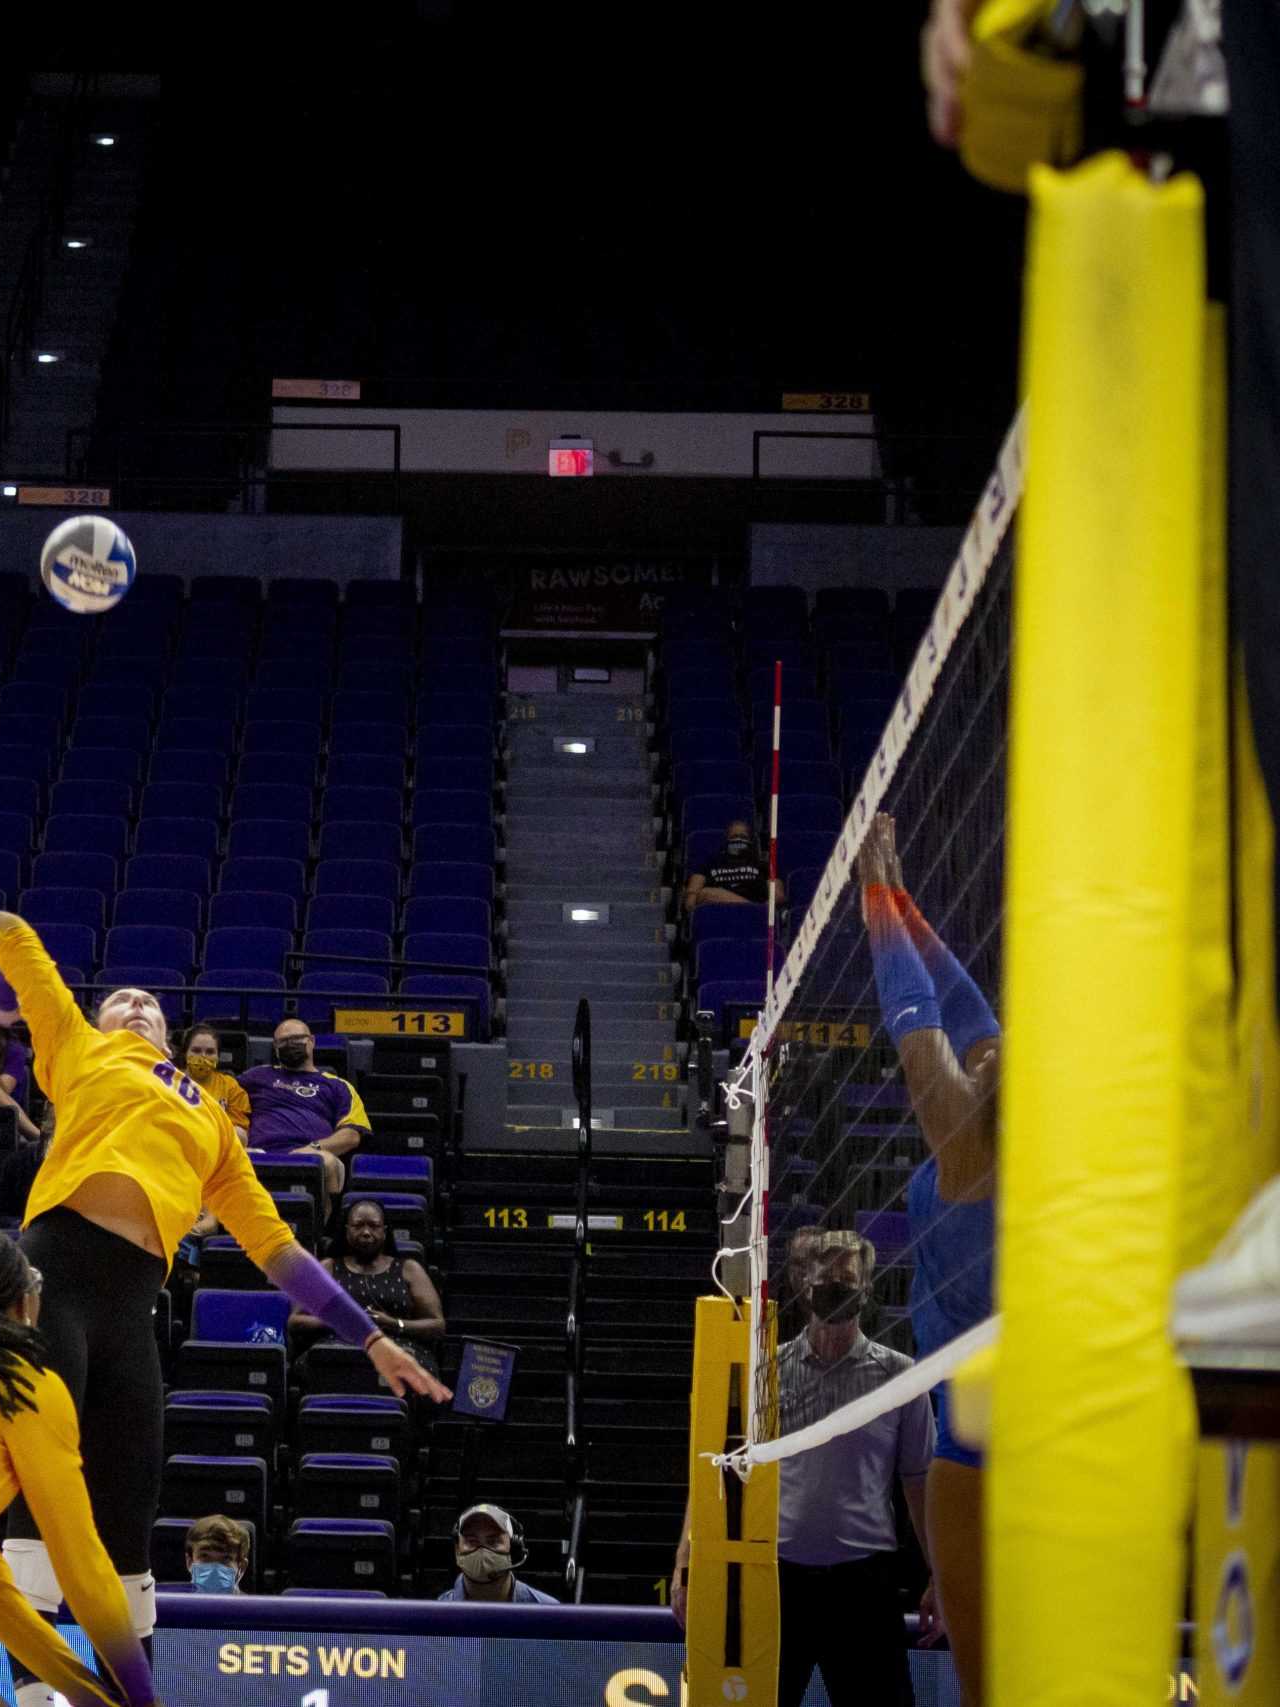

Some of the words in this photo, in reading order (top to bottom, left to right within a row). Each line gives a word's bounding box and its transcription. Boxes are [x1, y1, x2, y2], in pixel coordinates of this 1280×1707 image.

[820, 395, 863, 410] 328
[63, 489, 105, 505] 328
[391, 1013, 452, 1033] 113
[794, 1023, 857, 1045] 114
[509, 1062, 554, 1079] 218
[632, 1062, 680, 1081] 219
[483, 1207, 529, 1230] 113
[642, 1208, 688, 1231] 114
[217, 1644, 309, 1677] SETS
[317, 1646, 406, 1680] WON
